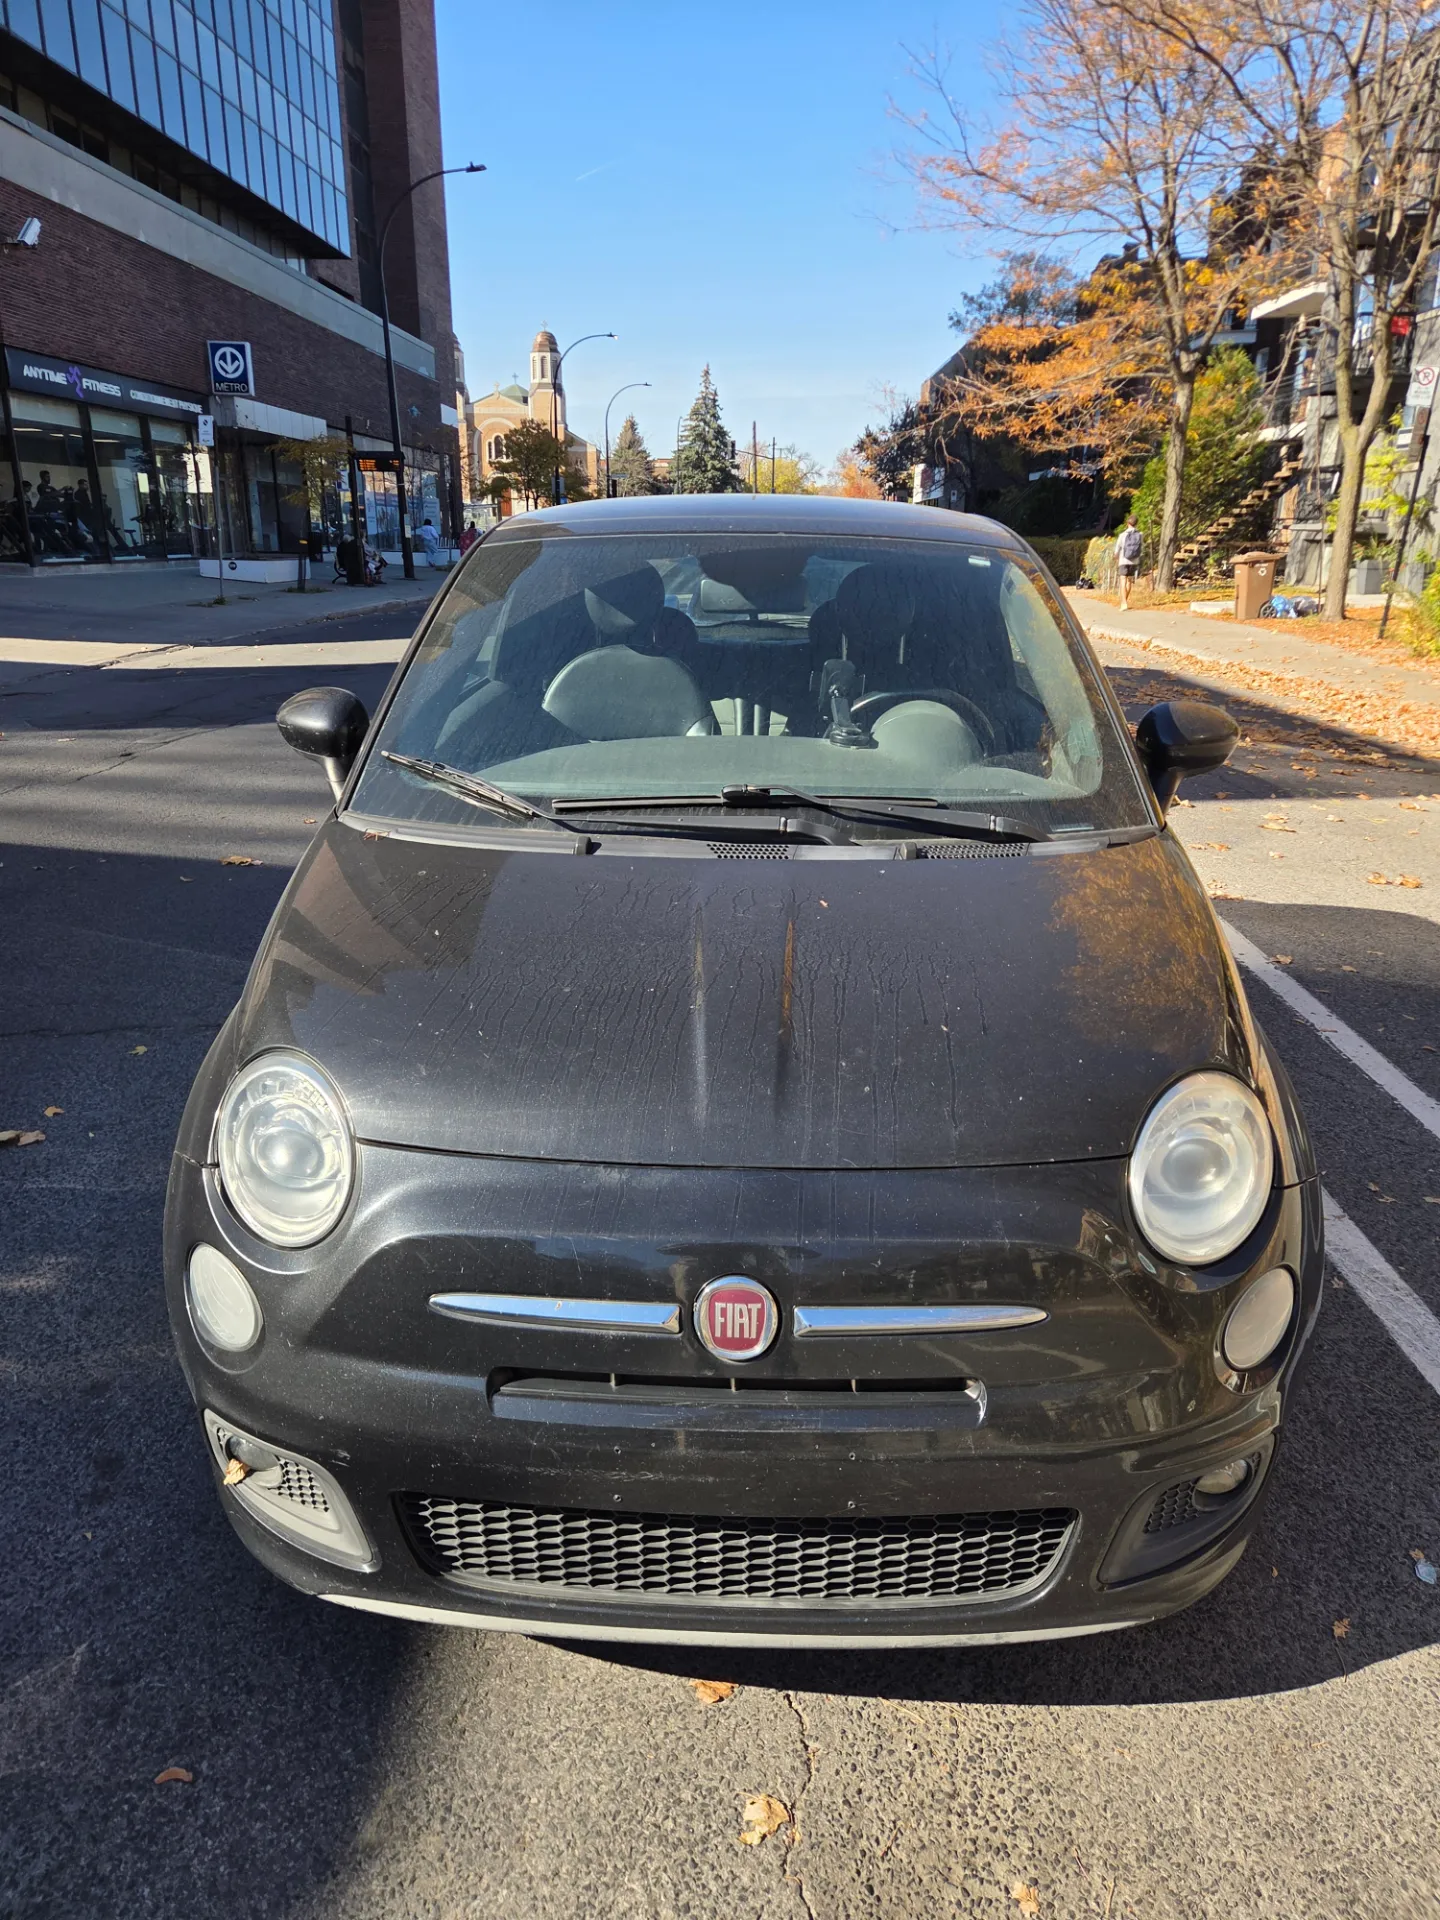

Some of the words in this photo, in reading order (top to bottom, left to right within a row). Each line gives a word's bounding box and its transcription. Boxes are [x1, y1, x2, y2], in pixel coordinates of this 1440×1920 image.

[23, 364, 68, 385] ANYTIME
[82, 377, 122, 398] FITNESS
[215, 382, 248, 393] METRO
[714, 1301, 762, 1340] FIAT
